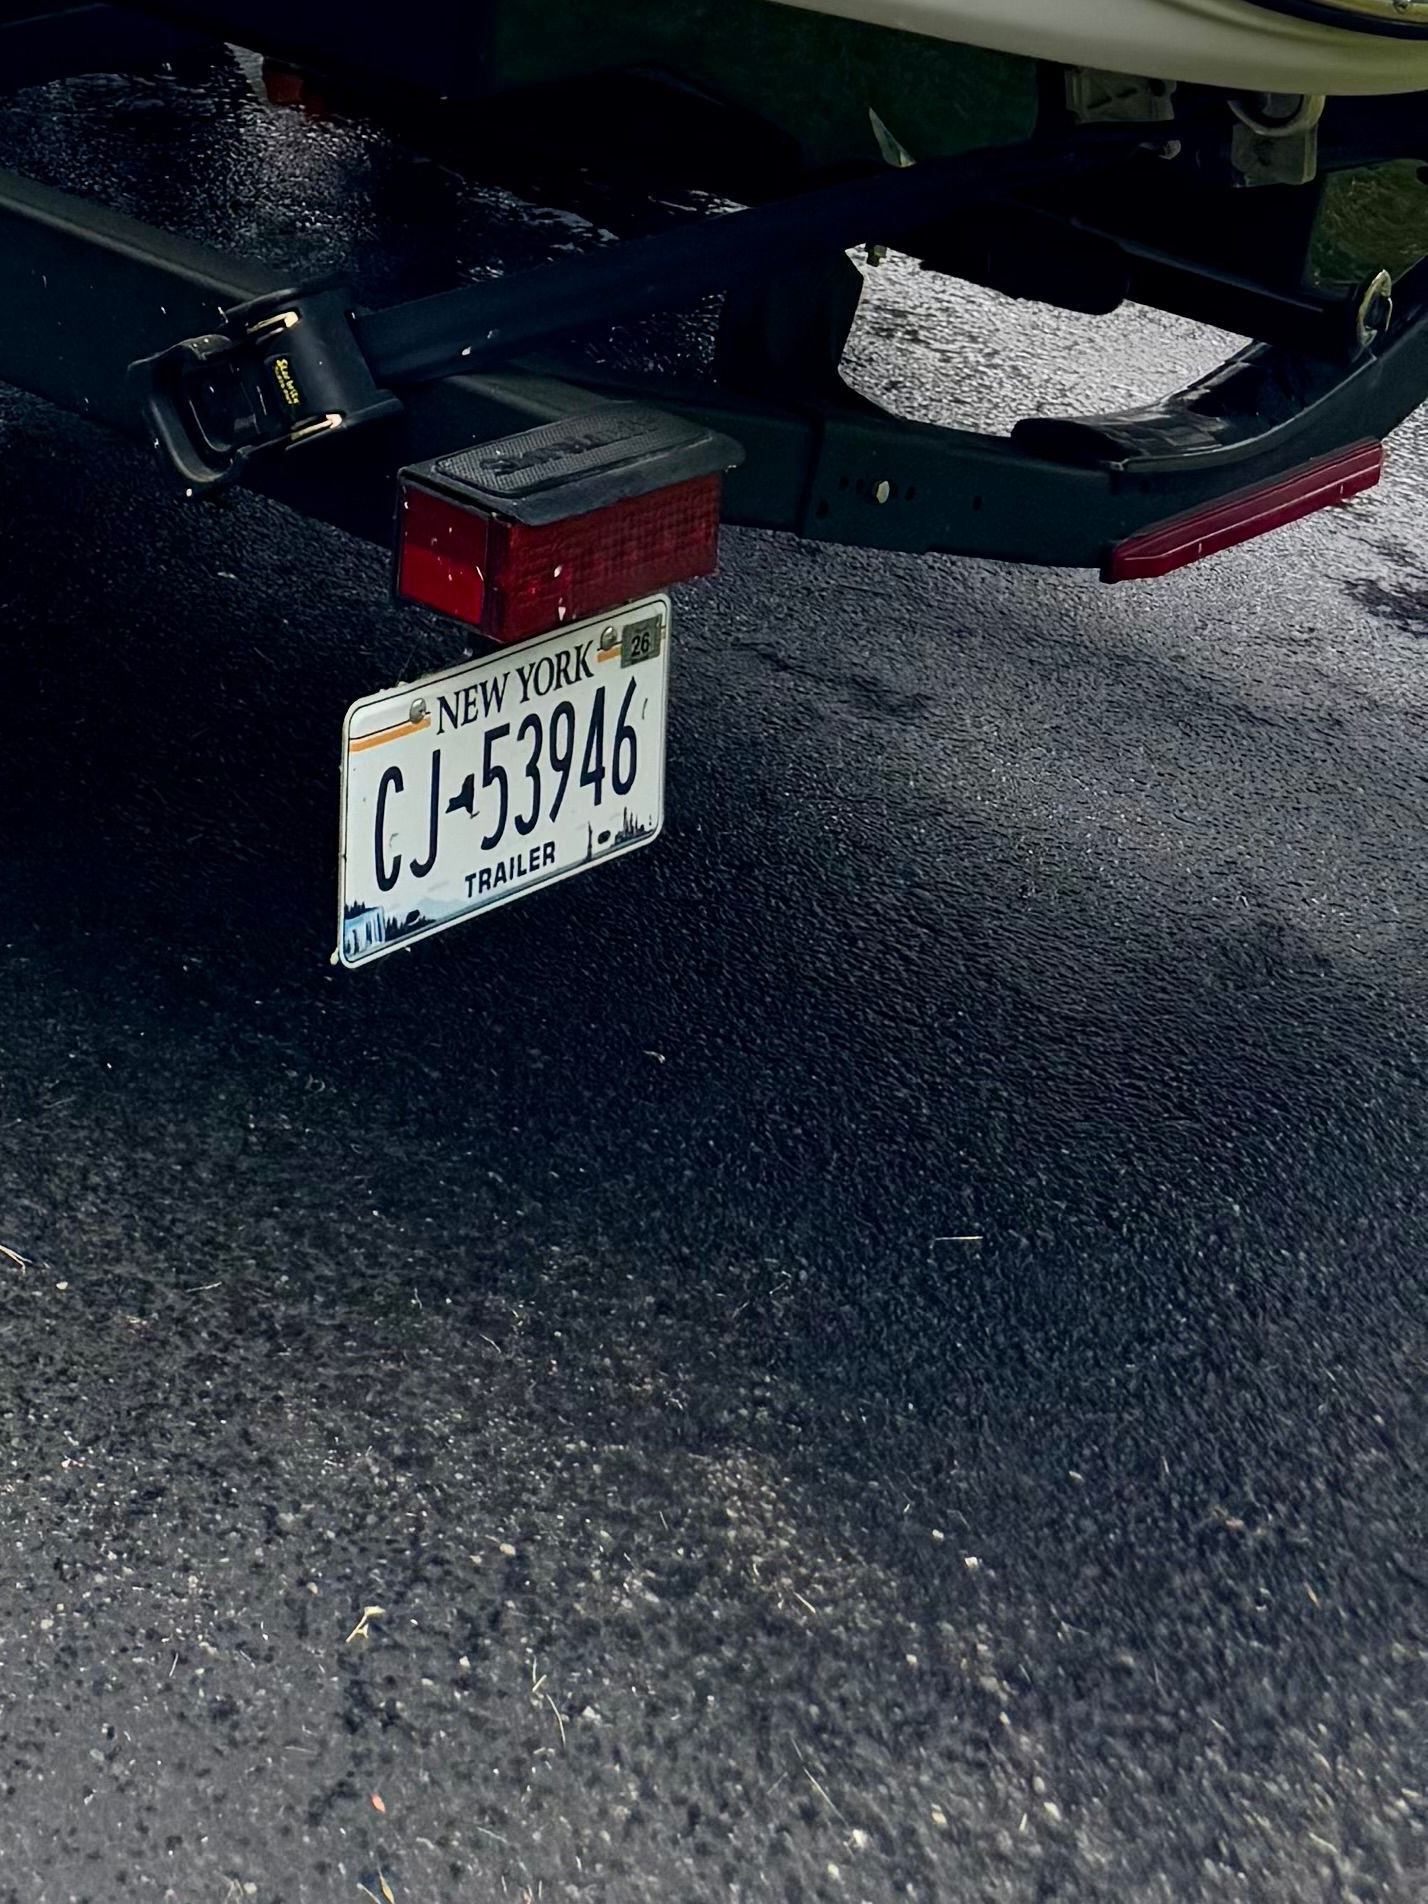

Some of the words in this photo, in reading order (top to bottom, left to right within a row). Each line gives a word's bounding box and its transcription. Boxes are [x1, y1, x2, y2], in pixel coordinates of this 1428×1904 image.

[631, 632, 650, 657] 26
[436, 671, 511, 736] NEW
[515, 639, 594, 704] YORK
[464, 840, 556, 898] TRAILER
